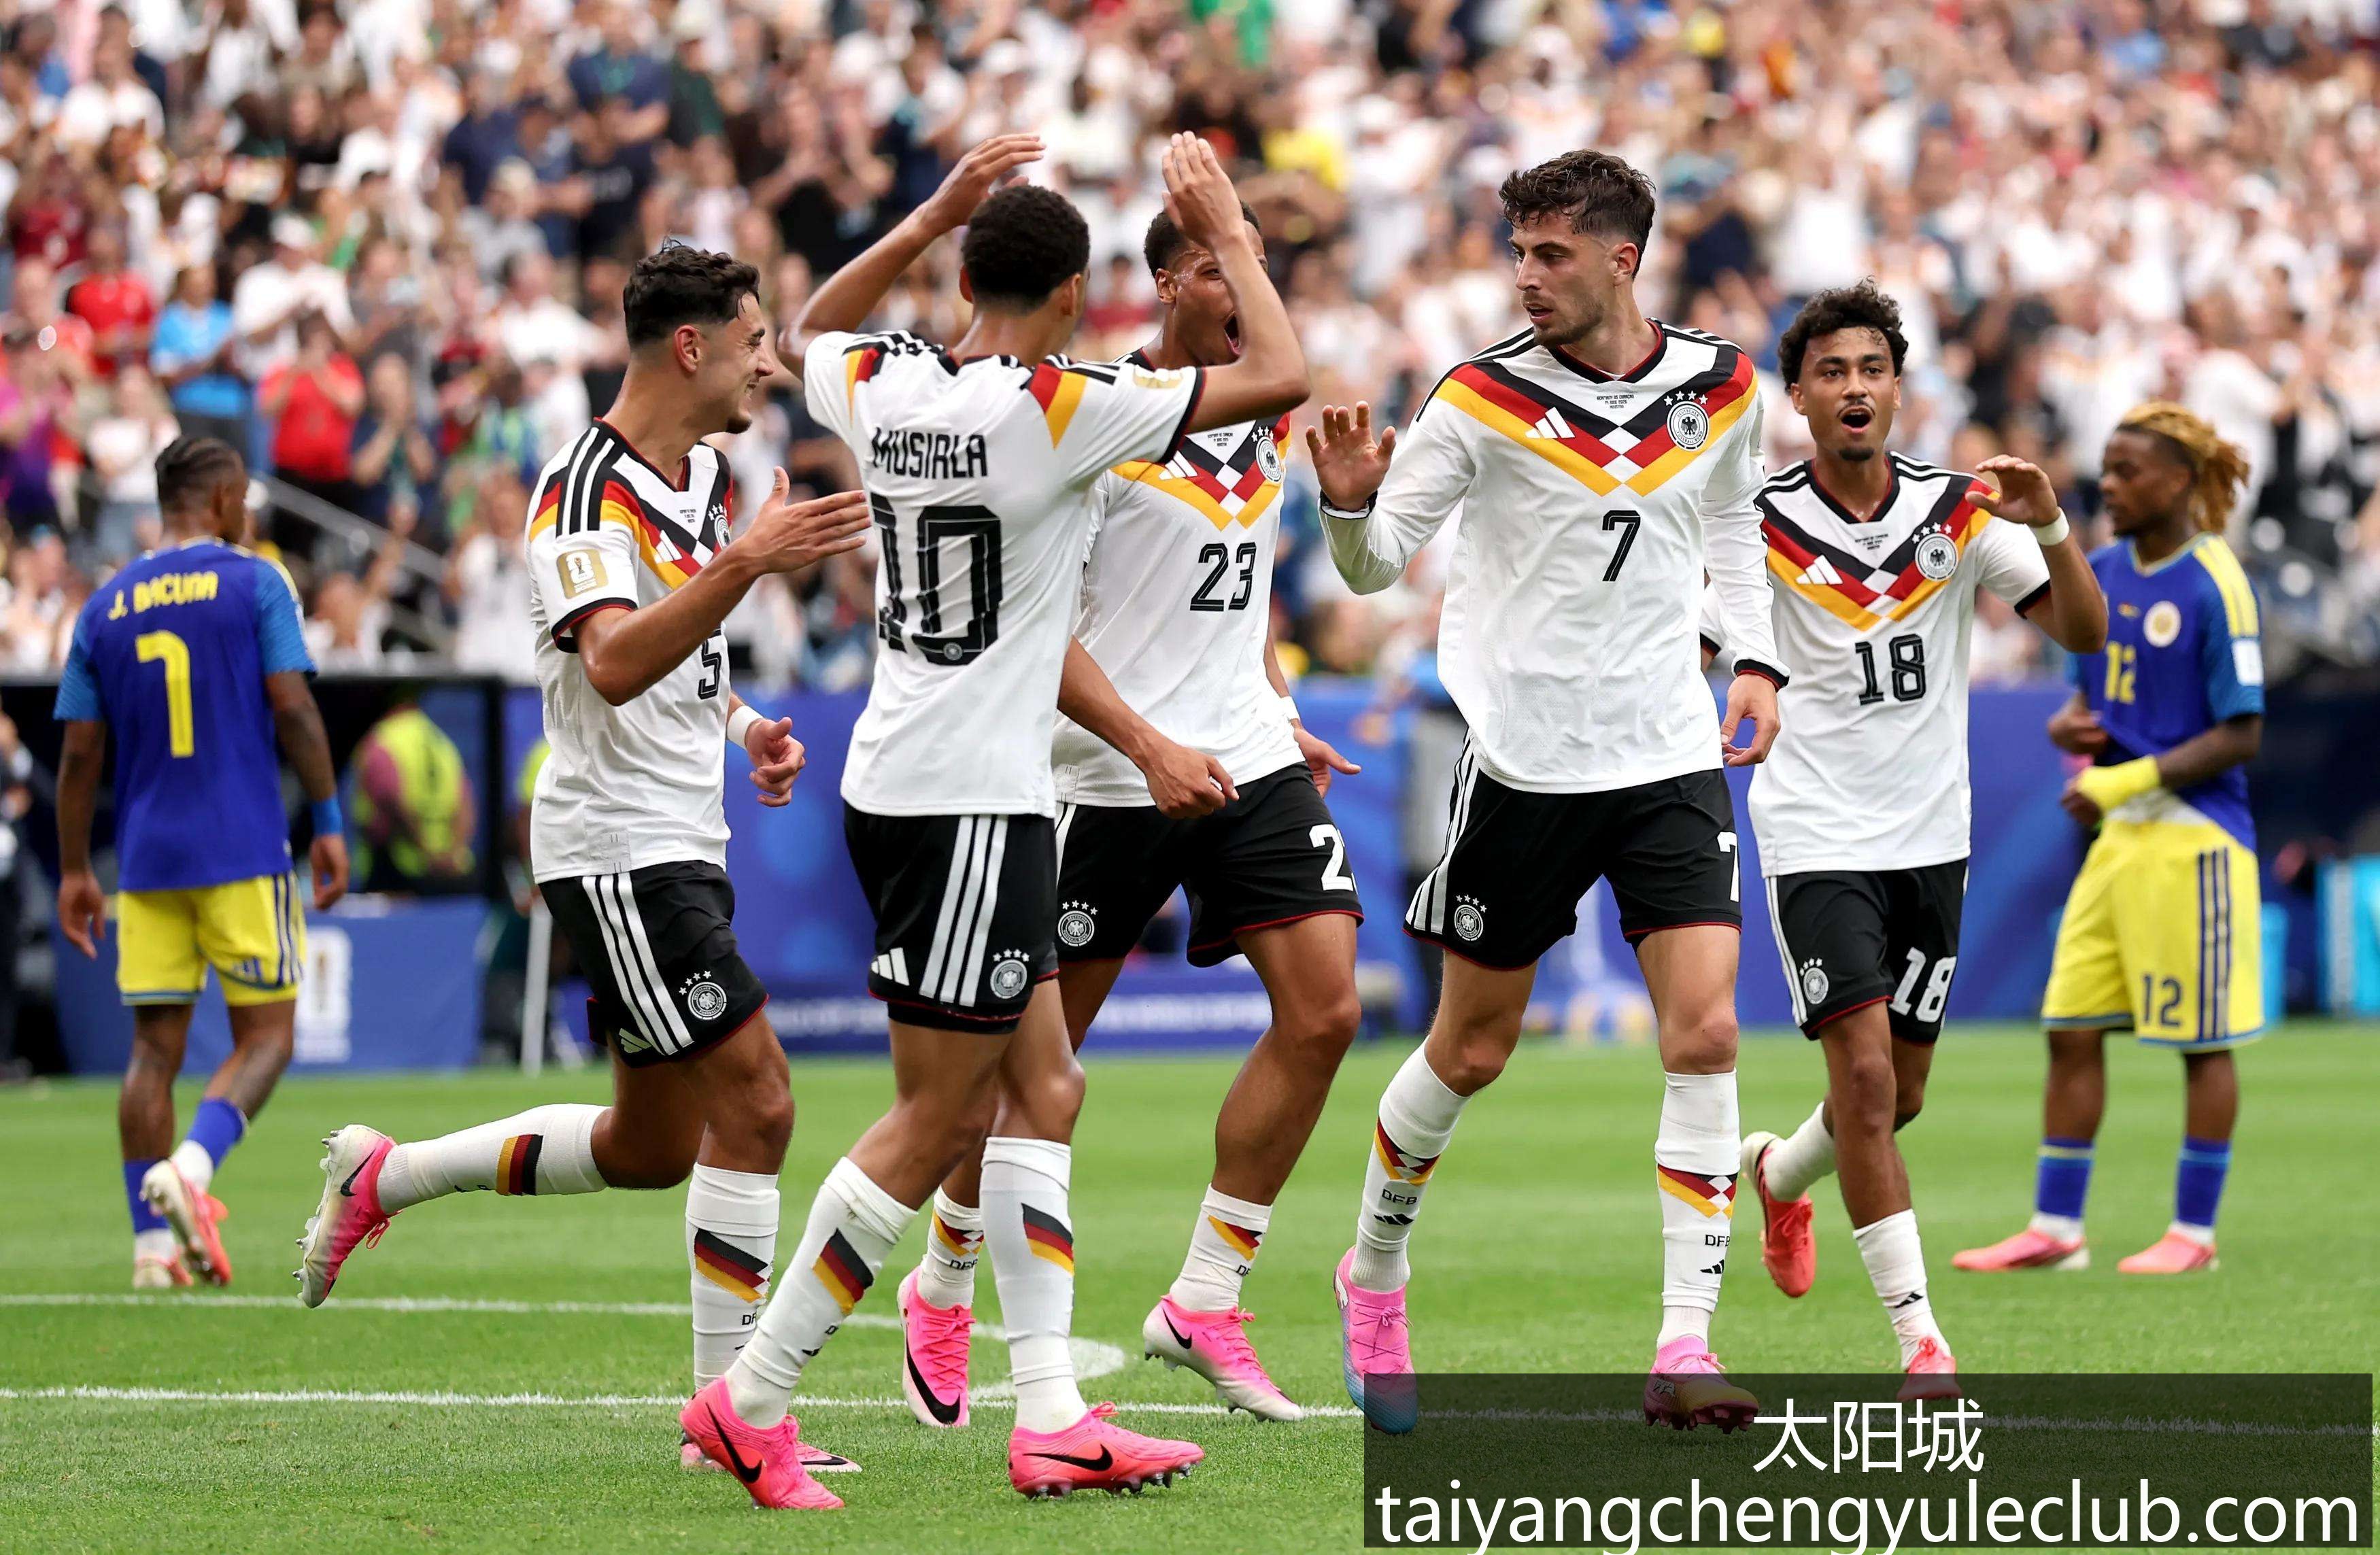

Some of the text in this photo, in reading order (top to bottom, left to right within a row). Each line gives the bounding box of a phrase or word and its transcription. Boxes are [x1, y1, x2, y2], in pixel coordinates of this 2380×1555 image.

[871, 427, 987, 479] MUSIALA
[870, 492, 1003, 666] 10
[1189, 542, 1257, 612] 23
[1601, 510, 1641, 582] 7
[107, 570, 219, 620] J. BACUNA
[698, 622, 722, 700] 5
[1855, 633, 1926, 706] 18
[2105, 641, 2137, 704] 12
[1308, 823, 1359, 893] 2
[1716, 831, 1739, 903] 7
[1888, 946, 1957, 1023] 18
[2143, 974, 2181, 1027] 12
[1382, 1189, 1418, 1205] DFB
[1705, 1234, 1731, 1247] DFB
[742, 1312, 757, 1325] DF
